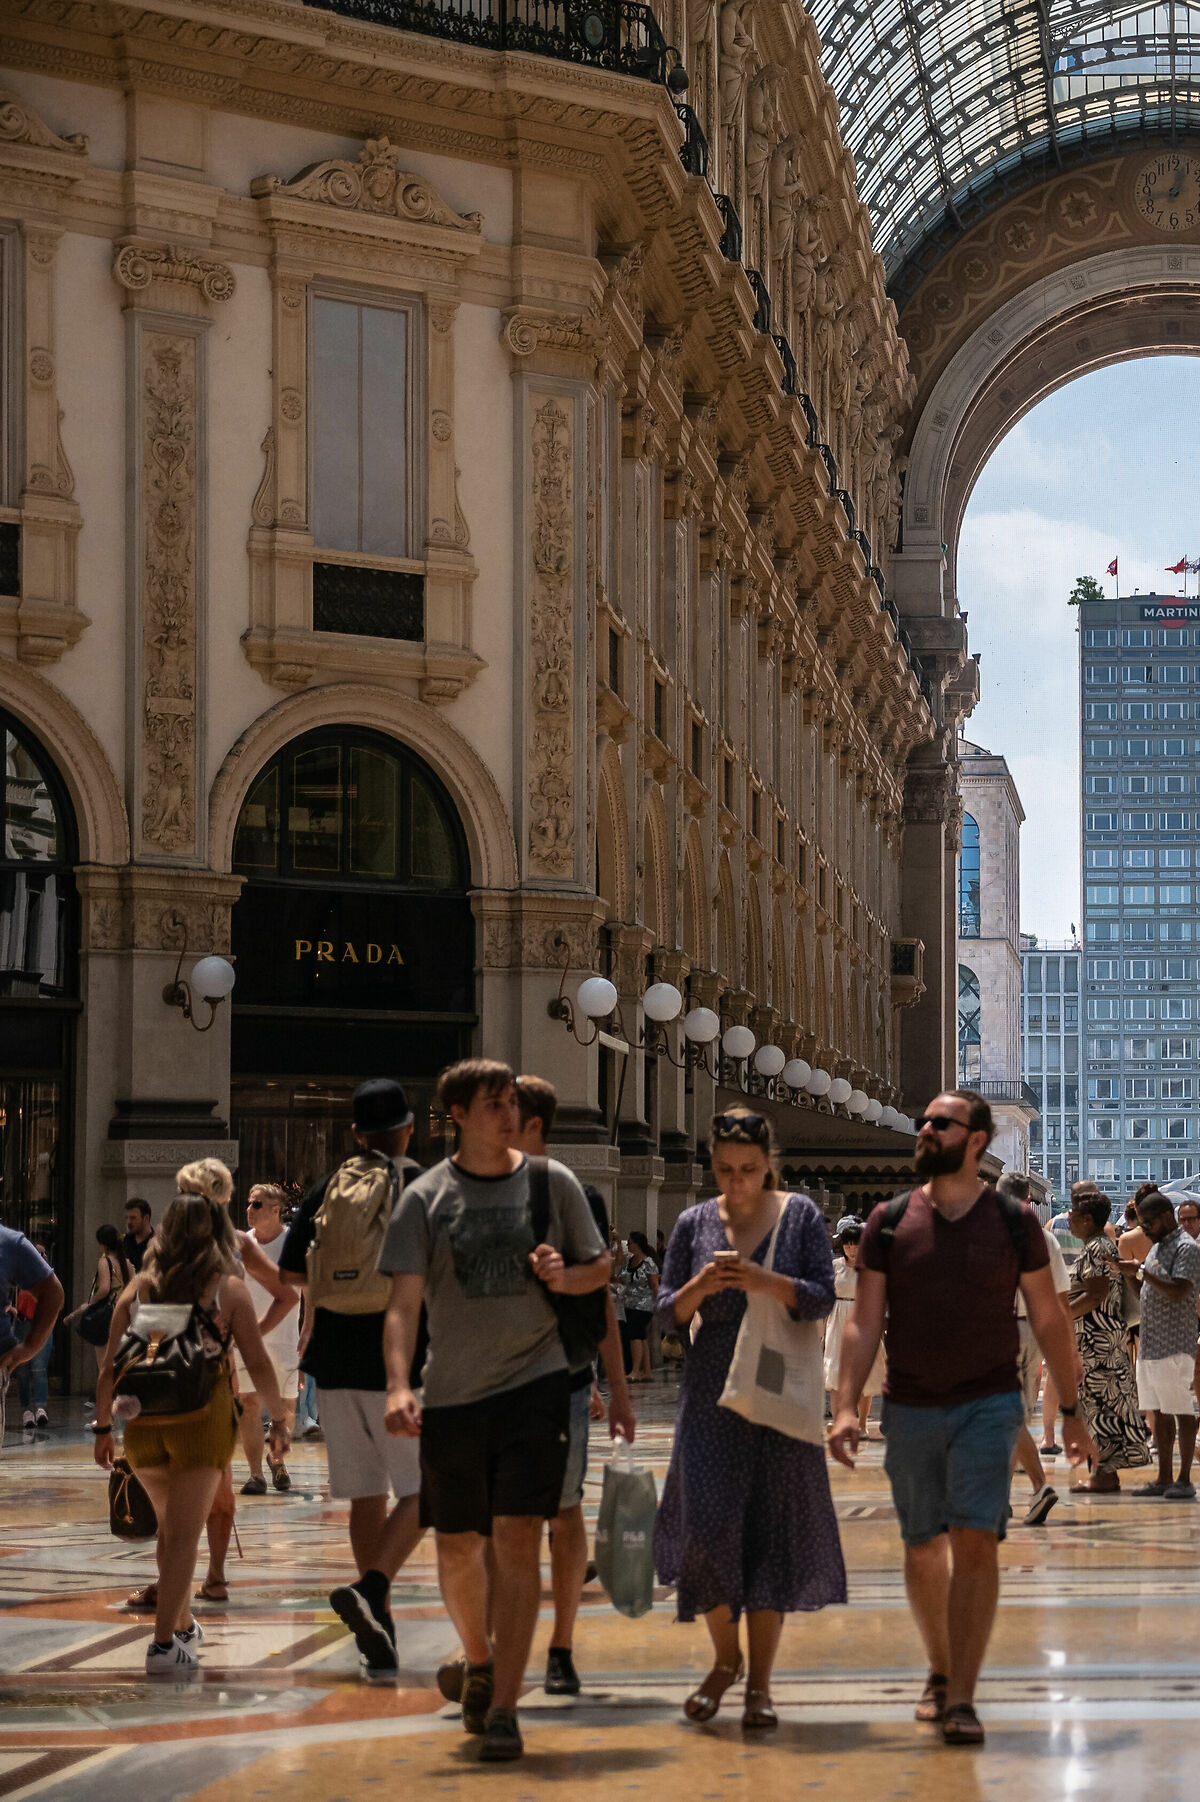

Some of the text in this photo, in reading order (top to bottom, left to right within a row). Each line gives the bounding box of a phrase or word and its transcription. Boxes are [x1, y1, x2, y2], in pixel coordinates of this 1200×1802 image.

[1157, 163, 1165, 176] 11
[1168, 156, 1180, 172] 12
[1144, 171, 1157, 186] 10
[1142, 185, 1151, 198] 9
[1146, 199, 1155, 214] 8
[1156, 210, 1164, 223] 7
[1169, 212, 1179, 227] 6
[1185, 209, 1194, 223] 5
[295, 939, 405, 966] PRADA
